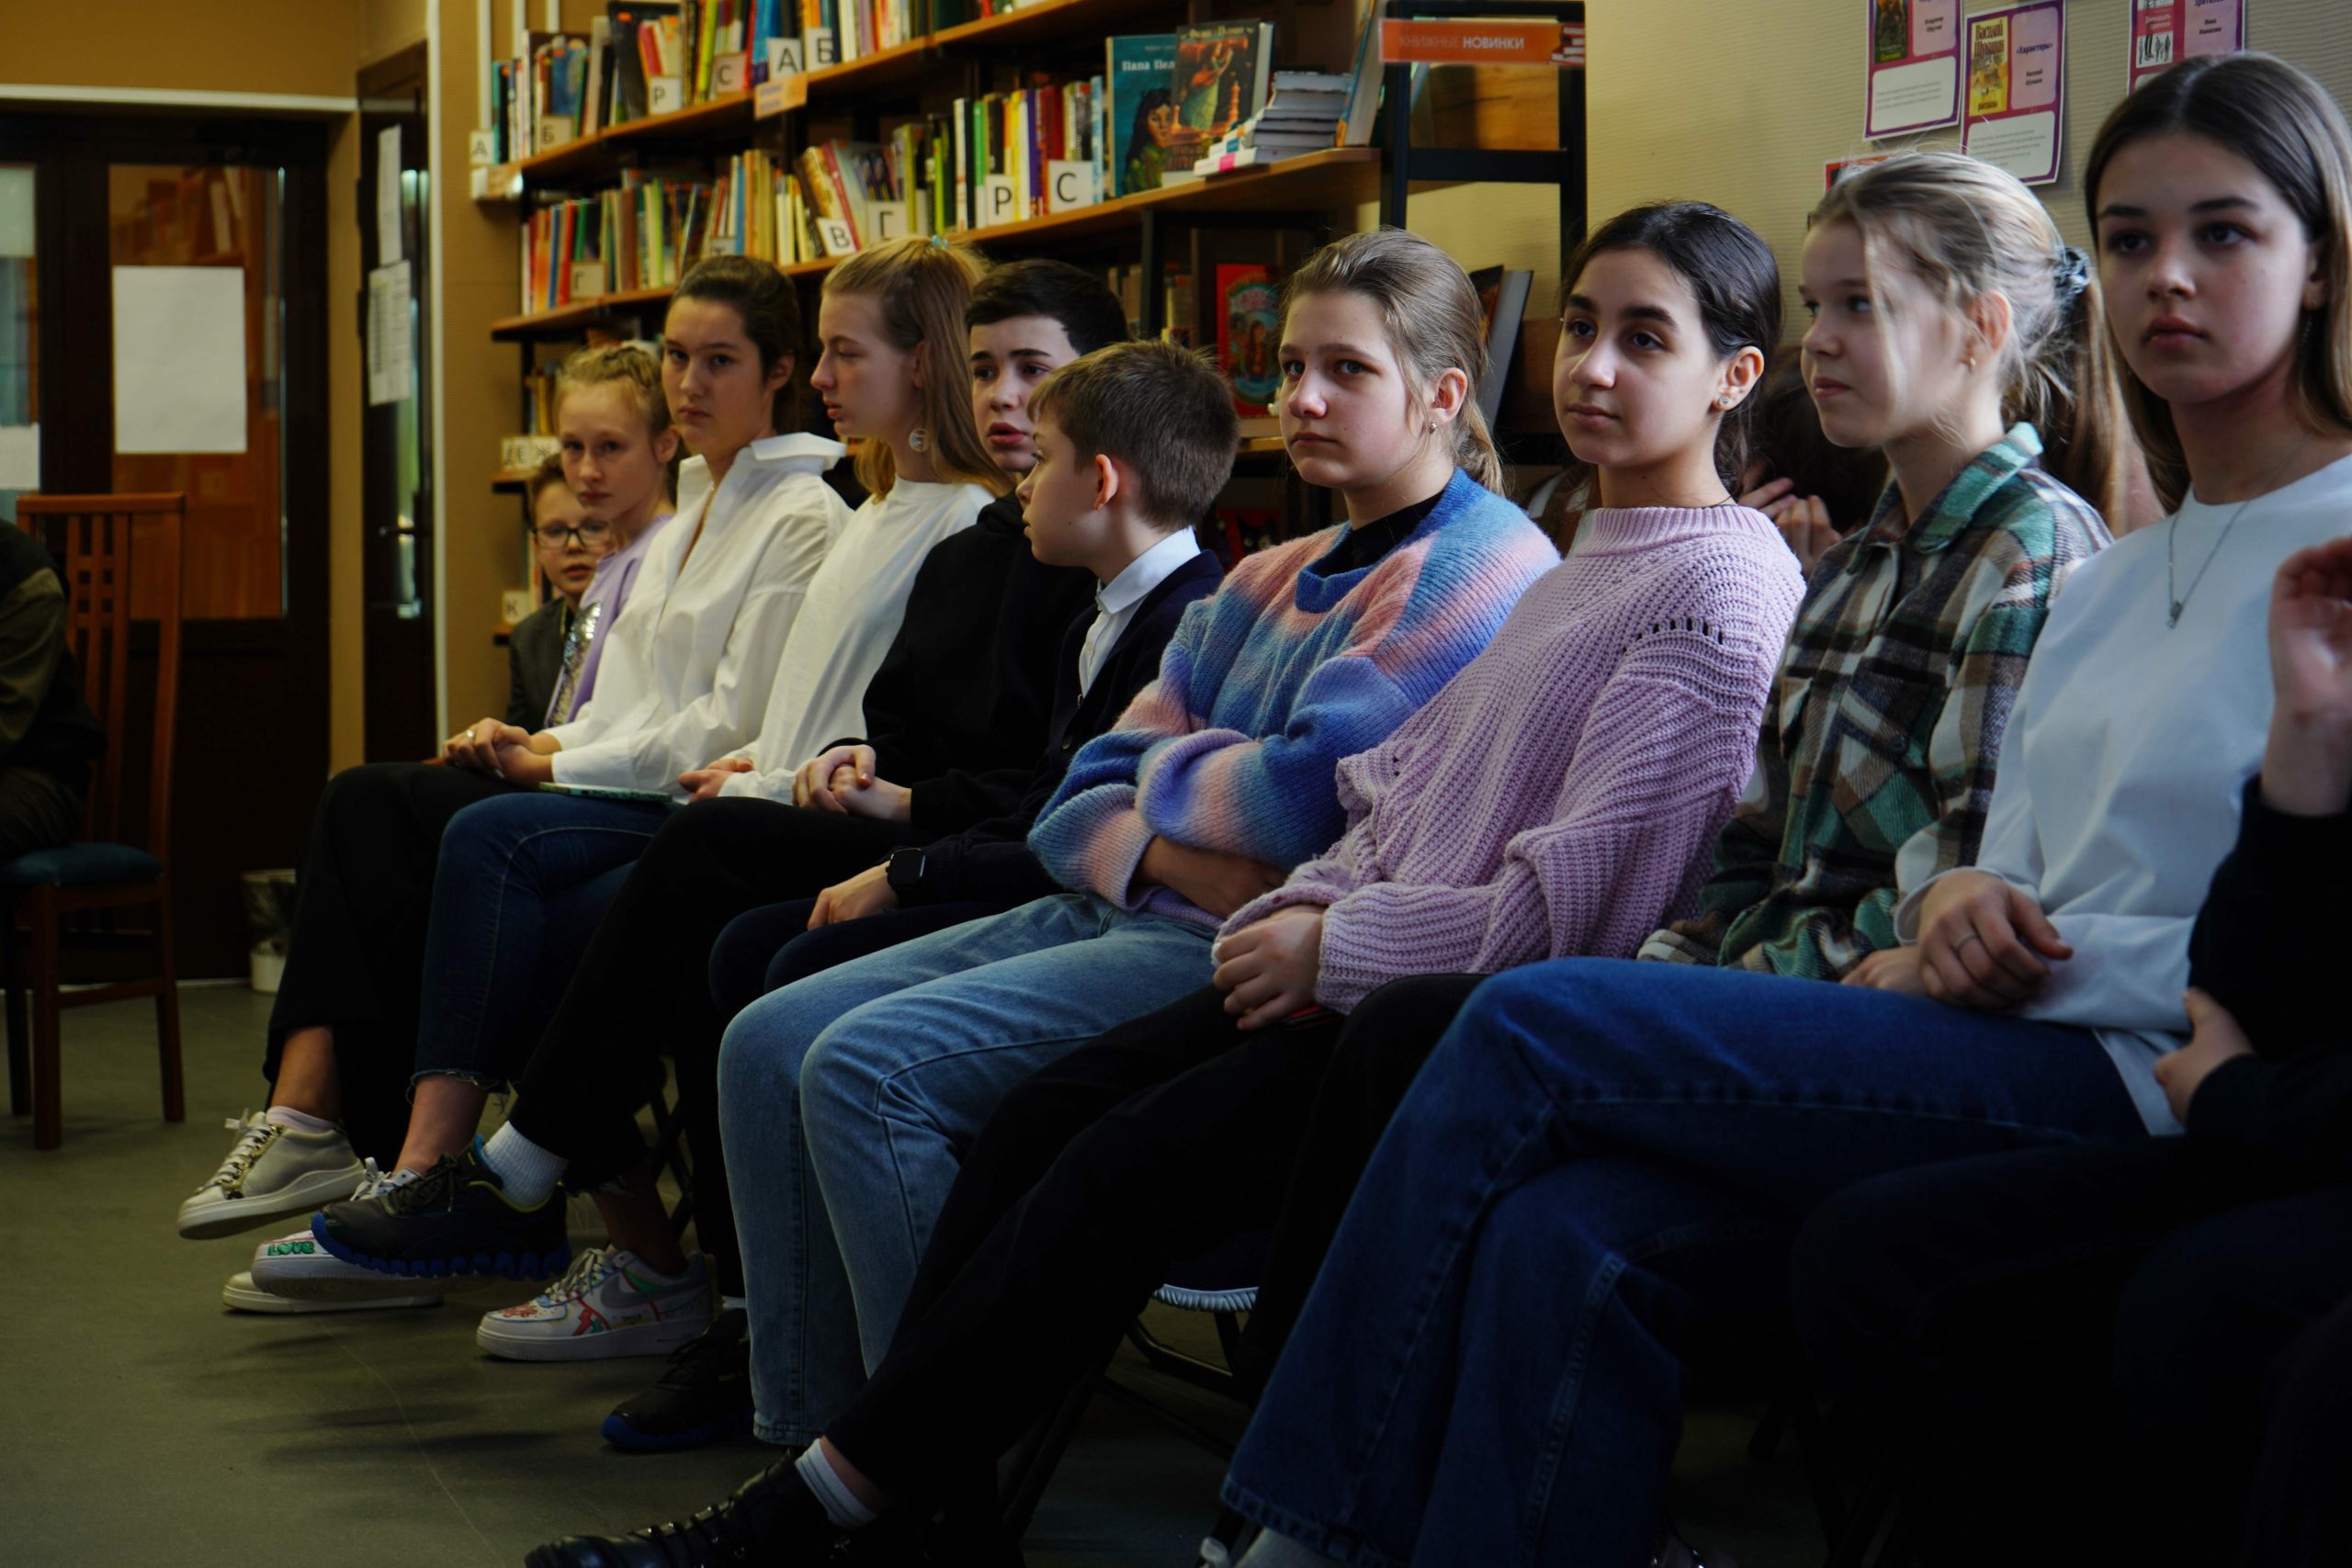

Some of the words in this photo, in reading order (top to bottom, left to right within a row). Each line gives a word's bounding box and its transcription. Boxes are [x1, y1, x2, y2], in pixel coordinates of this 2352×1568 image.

[1975, 19, 2004, 40] Василий
[1463, 37, 1525, 50] НОВИНКИ
[2016, 42, 2053, 55] «Характеры»
[777, 47, 799, 73] А
[718, 63, 734, 86] С
[653, 85, 666, 106] Р
[1056, 172, 1078, 203] С
[994, 186, 1012, 216] Р
[830, 225, 850, 249] В
